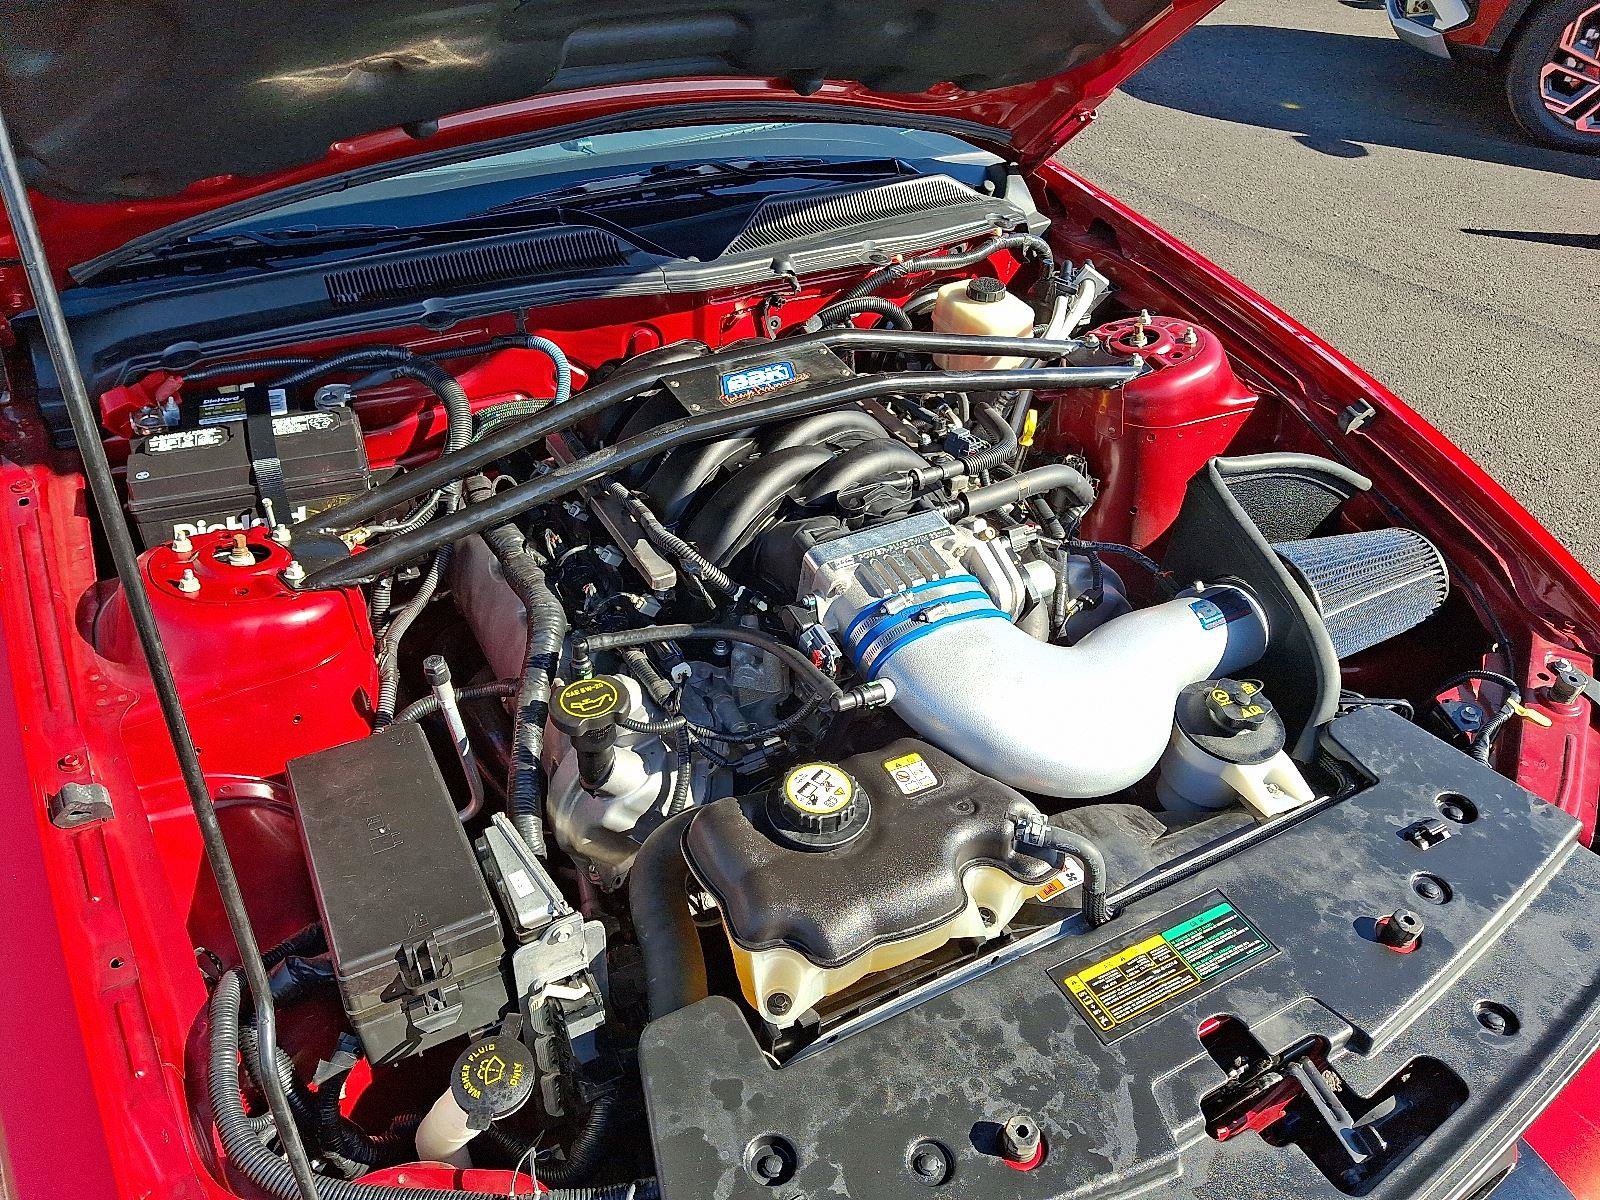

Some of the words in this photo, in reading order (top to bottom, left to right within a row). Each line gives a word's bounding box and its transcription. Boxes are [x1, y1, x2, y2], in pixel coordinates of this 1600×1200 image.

[467, 1043, 496, 1062] FLUID
[461, 1064, 481, 1099] WASHER
[509, 1062, 524, 1087] ONLY
